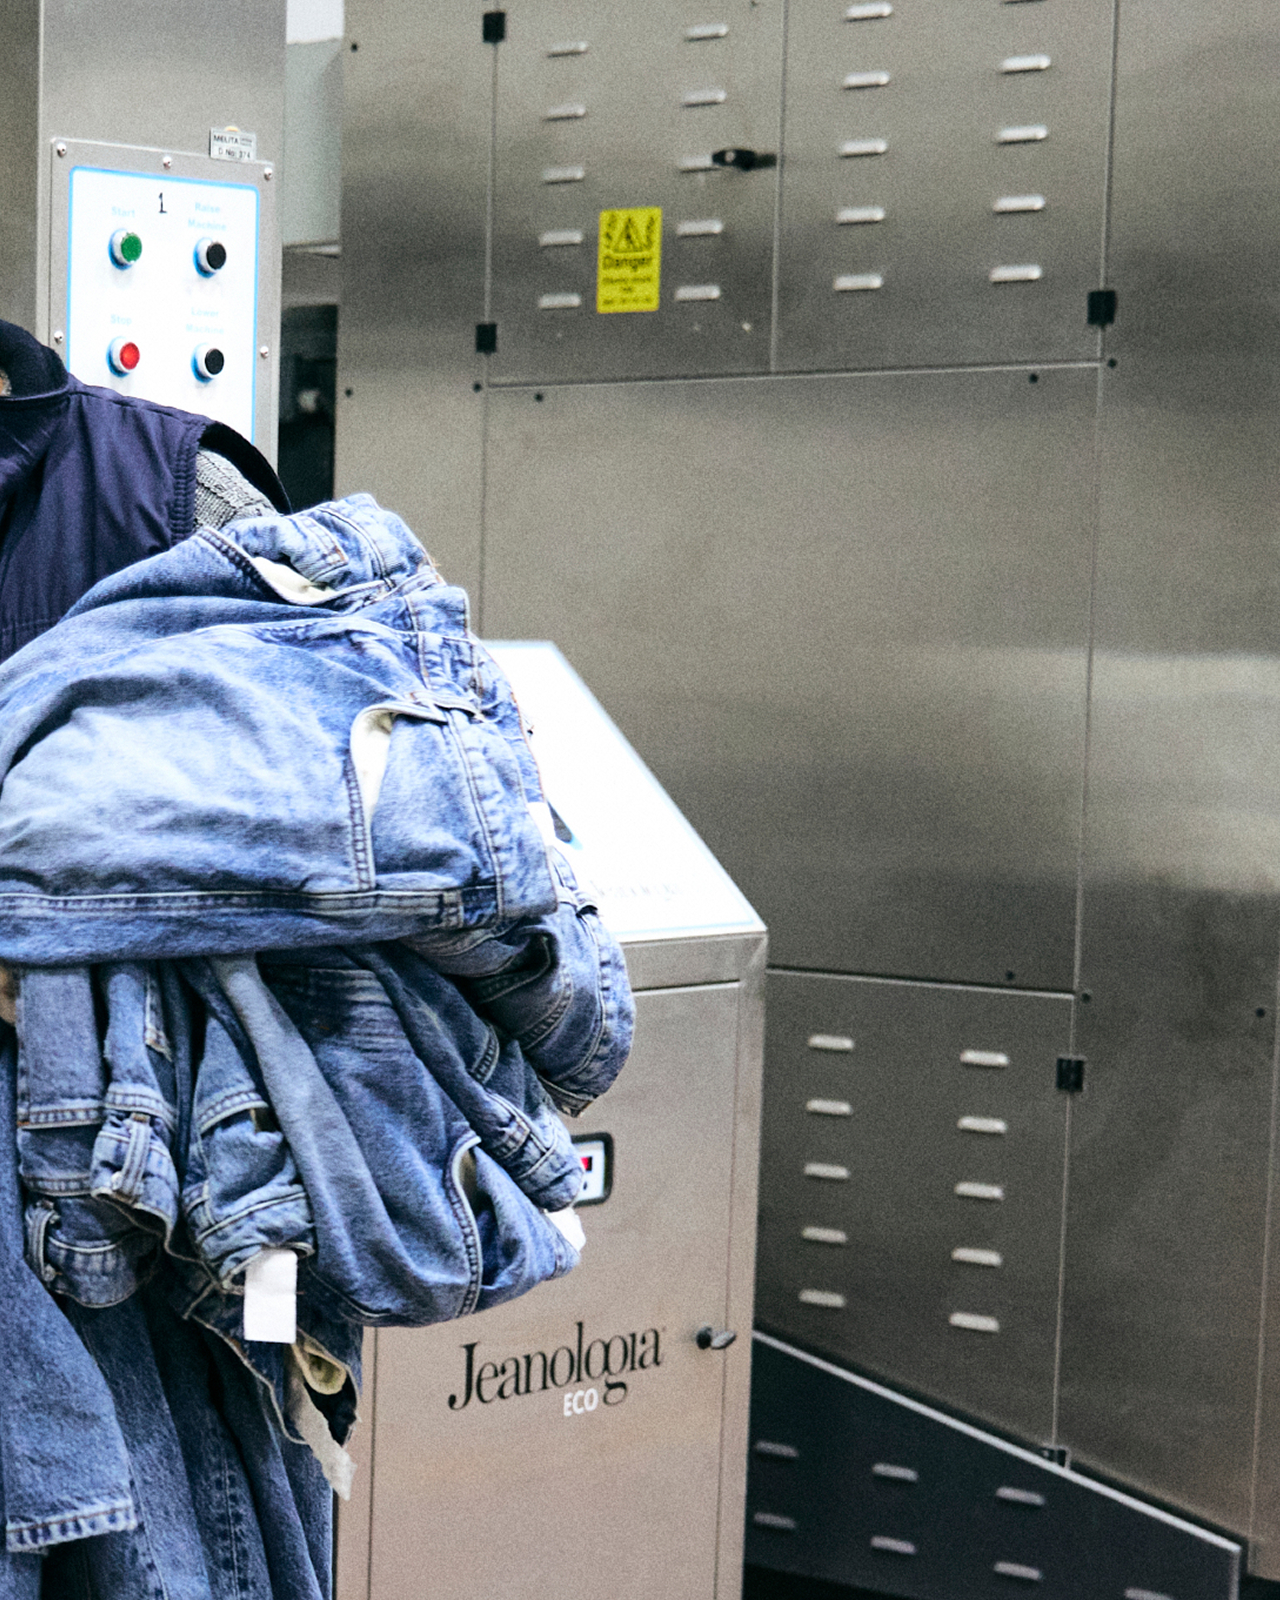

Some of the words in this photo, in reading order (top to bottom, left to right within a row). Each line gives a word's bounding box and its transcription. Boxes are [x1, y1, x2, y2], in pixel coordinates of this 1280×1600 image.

[213, 134, 238, 144] MELITA
[158, 192, 168, 214] 1
[194, 202, 221, 214] Raise
[111, 205, 136, 218] Start
[187, 218, 227, 231] Machine
[602, 255, 653, 272] Danger
[191, 306, 220, 318] Lower
[110, 314, 133, 327] Stop
[185, 323, 225, 335] Machine
[448, 1321, 663, 1410] Jeanologia
[563, 1388, 599, 1417] ECO
